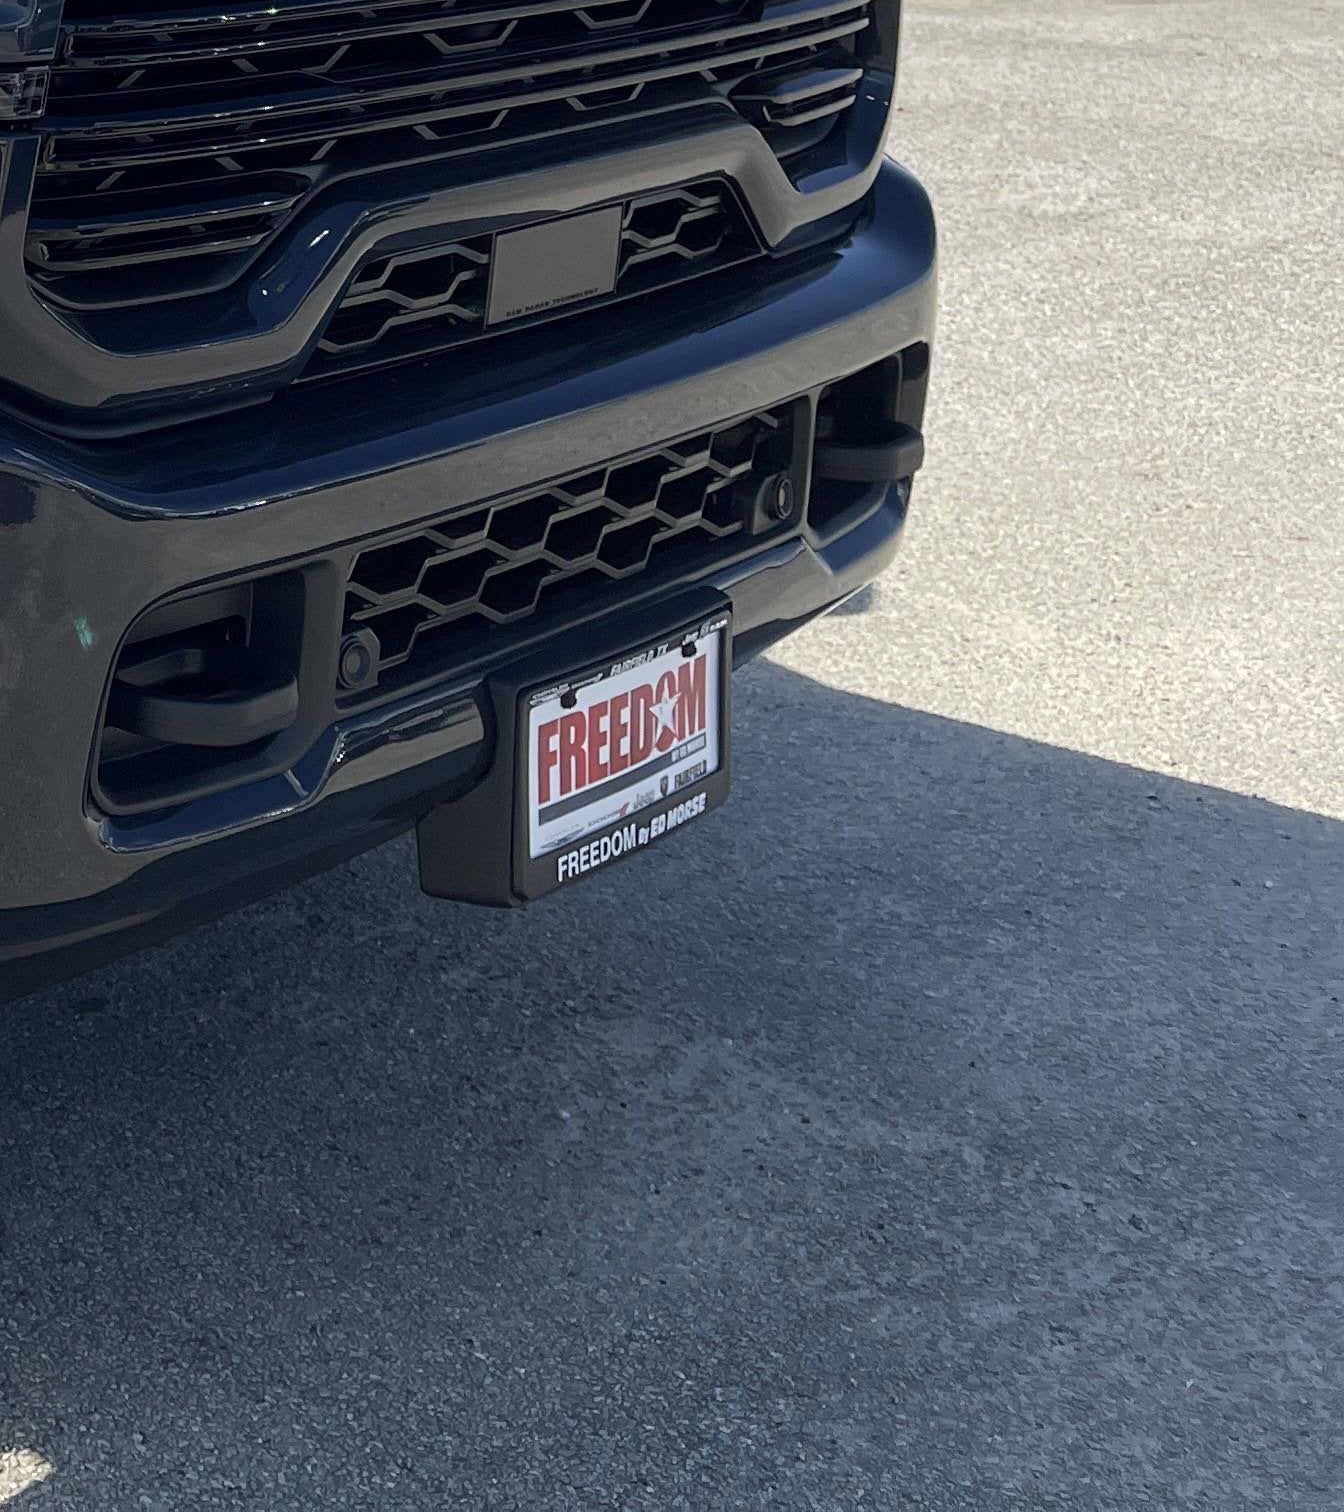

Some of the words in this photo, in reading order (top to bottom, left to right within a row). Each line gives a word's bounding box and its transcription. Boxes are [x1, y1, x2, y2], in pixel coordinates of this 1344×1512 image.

[538, 654, 707, 805] FREEDOM
[557, 823, 637, 883] FREEDOM
[650, 813, 666, 839] ED
[666, 792, 707, 831] MORSE
